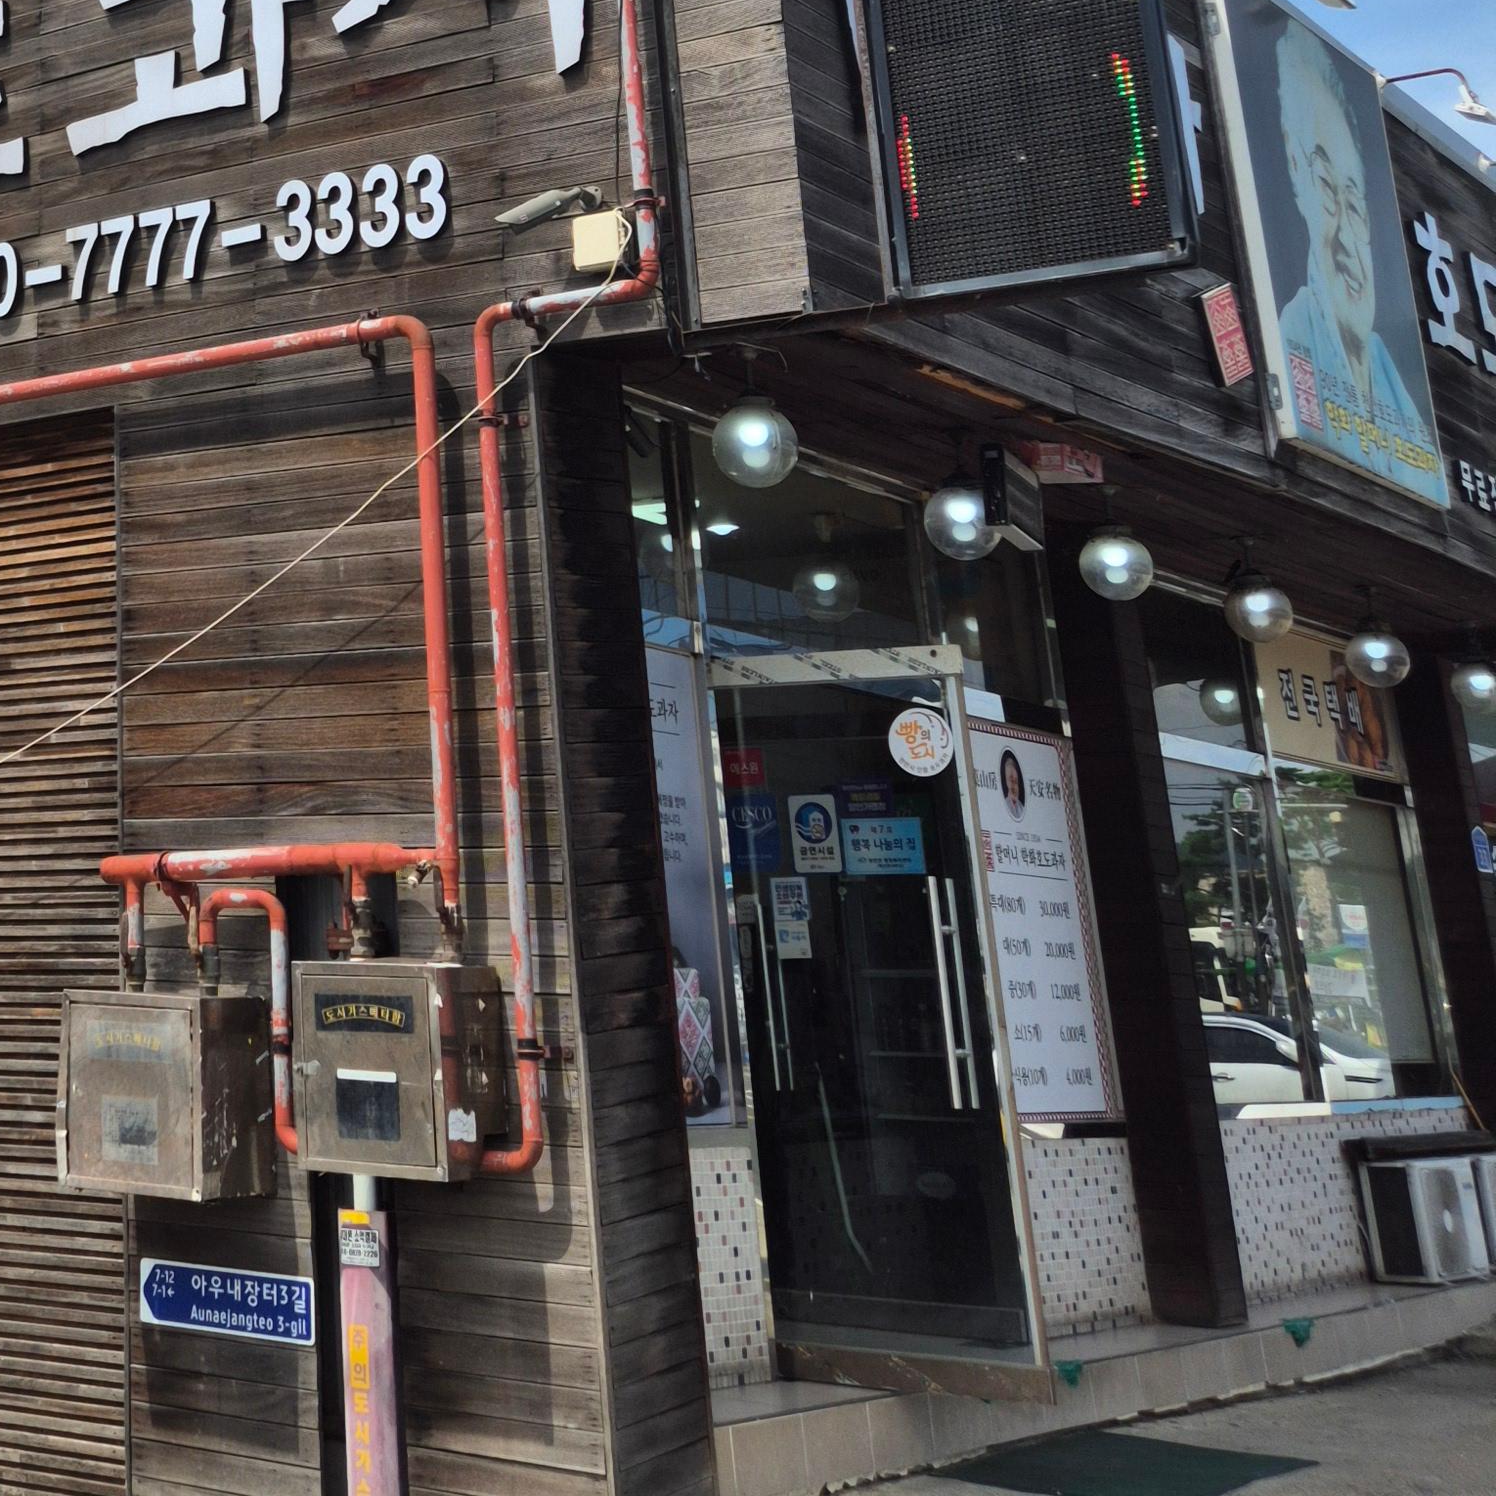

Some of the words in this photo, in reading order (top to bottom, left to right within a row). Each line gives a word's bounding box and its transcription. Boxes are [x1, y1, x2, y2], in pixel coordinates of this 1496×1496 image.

[1044, 941, 1076, 960] 20,000원
[1050, 982, 1081, 1002] 12,000원
[1060, 1024, 1087, 1044] 6,000원
[154, 1269, 175, 1284] 7-12
[152, 1284, 166, 1298] 7-1
[191, 1274, 307, 1314] 아우내장터3길
[190, 1304, 274, 1332] Aunaejangteo
[277, 1316, 307, 1337] 3-gil
